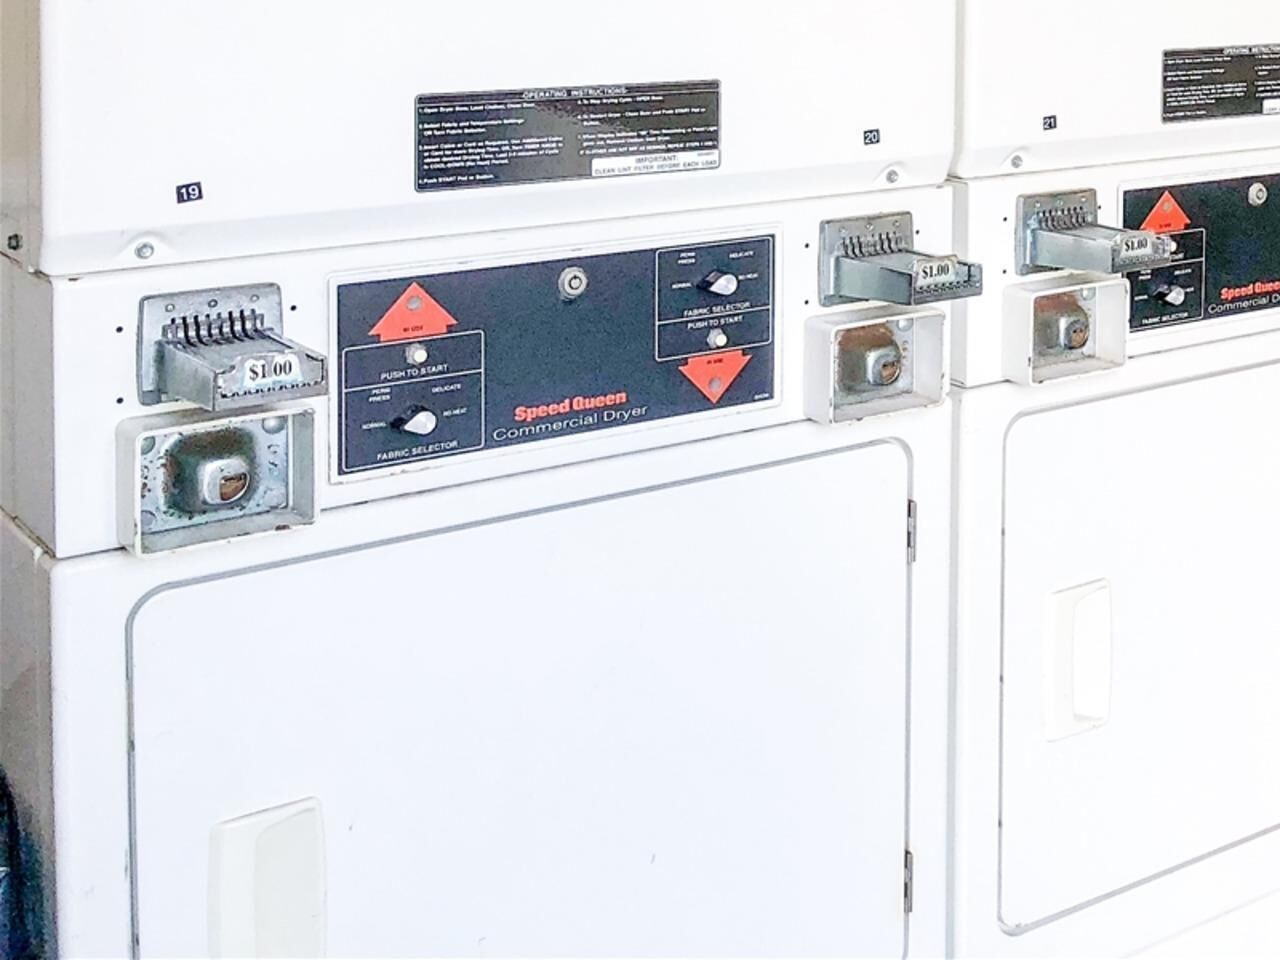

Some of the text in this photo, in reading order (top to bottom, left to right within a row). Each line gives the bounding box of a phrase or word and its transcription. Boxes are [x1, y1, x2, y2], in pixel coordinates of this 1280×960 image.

[522, 87, 627, 99] OPERATING INSTRUCTIONS
[1044, 117, 1056, 129] 21
[864, 131, 879, 143] 20
[179, 184, 200, 202] 19
[921, 262, 951, 280] $1.00
[1220, 283, 1253, 300] Speed
[683, 301, 751, 317] FABRIC SELECTOR
[1207, 295, 1270, 314] Commercial
[687, 315, 743, 329] PUSH TO START
[249, 359, 293, 382] $100
[380, 363, 449, 381] PUSH TO START
[514, 391, 628, 422] Speed Queen
[492, 405, 649, 441] Commercial Dryer
[376, 439, 459, 461] FABRIC SELECTOR
